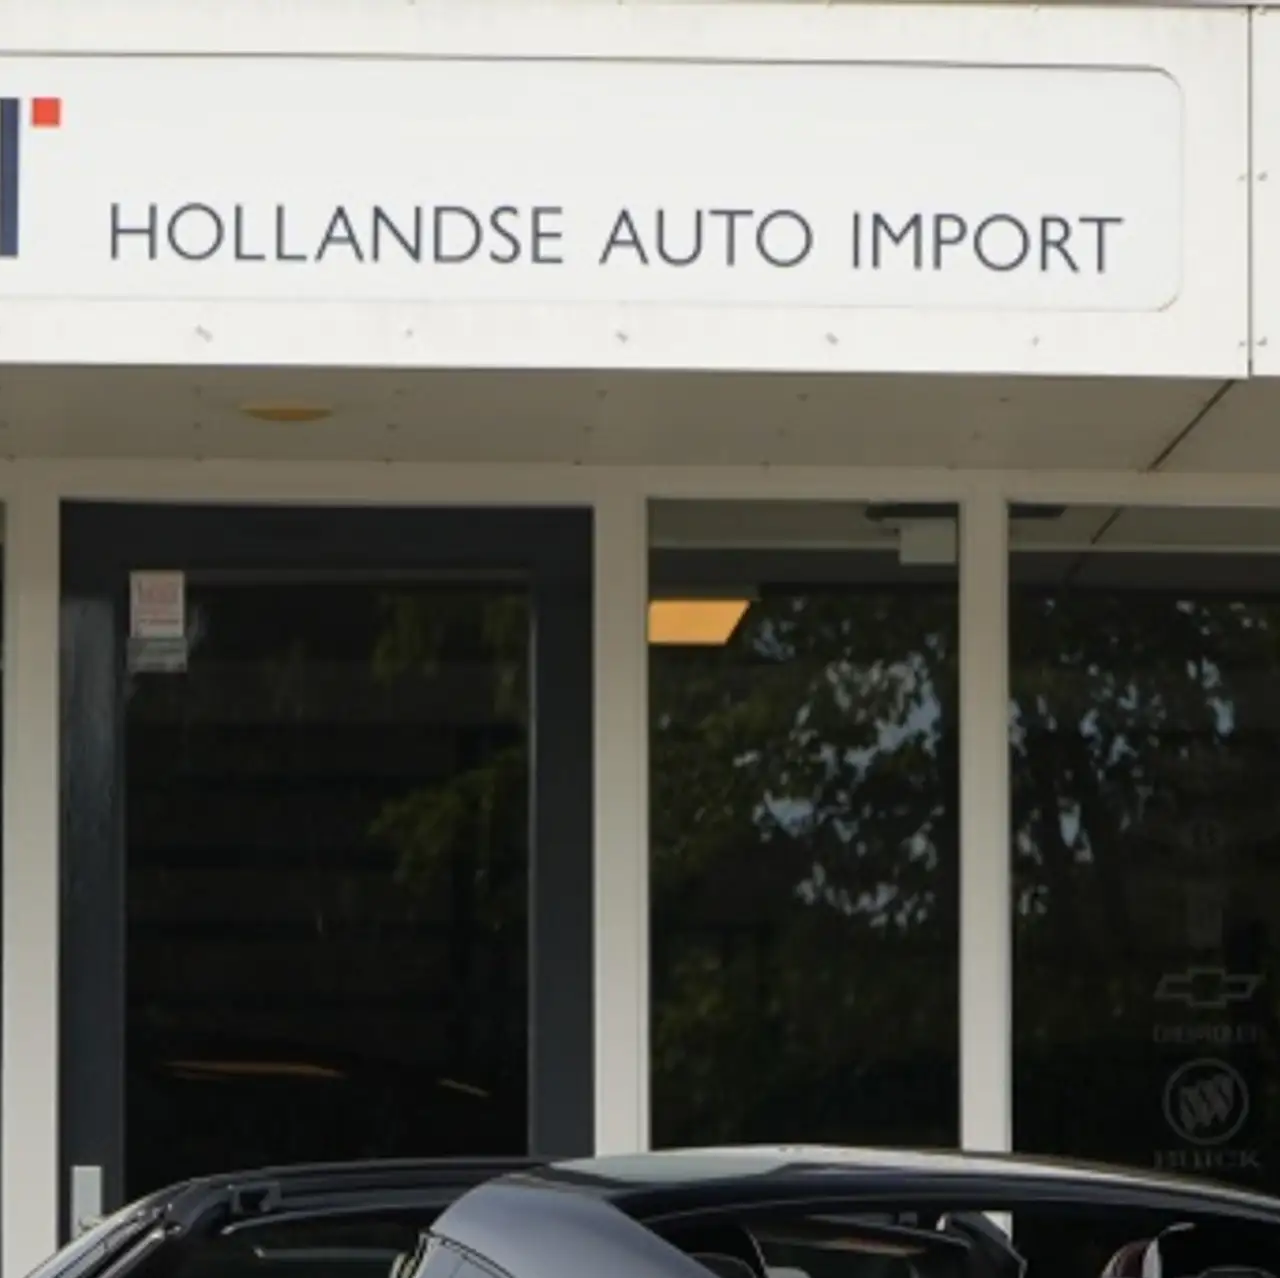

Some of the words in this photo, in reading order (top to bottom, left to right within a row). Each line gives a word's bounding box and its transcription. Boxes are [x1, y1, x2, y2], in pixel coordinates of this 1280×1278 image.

[110, 201, 564, 265] HOLLANDSE
[598, 207, 814, 269] AUTO
[851, 211, 1124, 274] IMPORT
